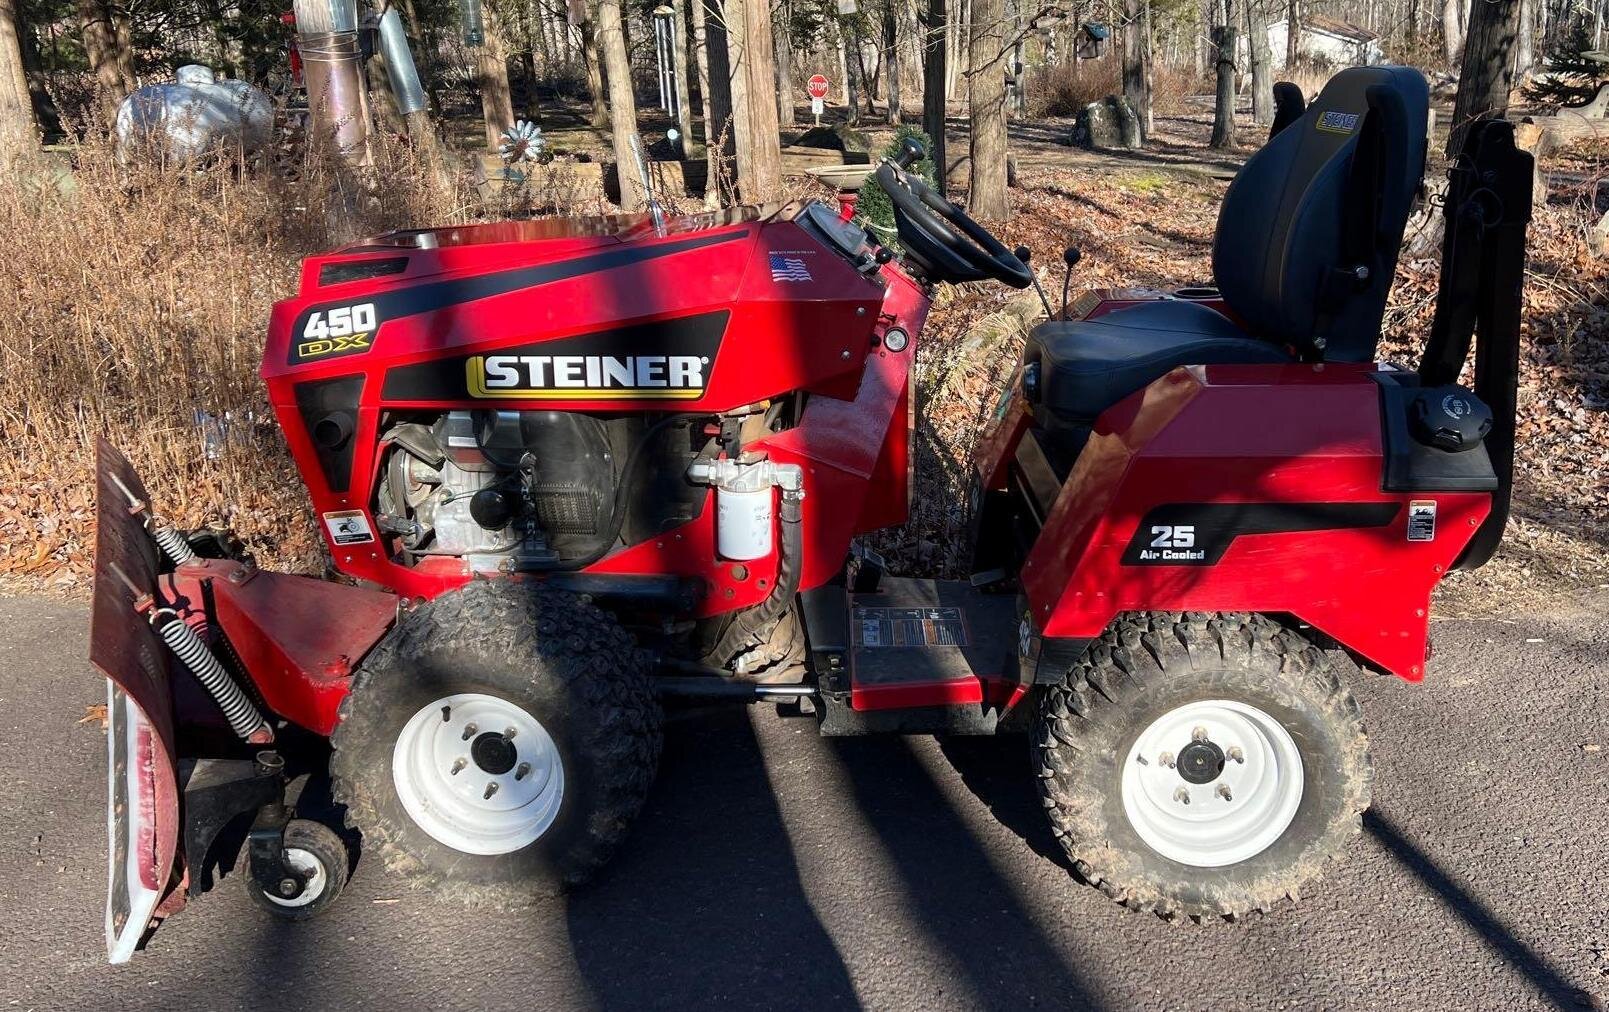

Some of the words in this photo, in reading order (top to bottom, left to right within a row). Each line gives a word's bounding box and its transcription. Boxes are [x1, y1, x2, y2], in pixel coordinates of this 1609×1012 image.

[810, 81, 827, 91] STOP
[303, 303, 376, 339] 450
[298, 332, 370, 357] DX
[485, 355, 703, 388] STEINER
[1150, 525, 1195, 548] 25
[1140, 549, 1160, 560] Air
[1162, 549, 1205, 560] Cooled
